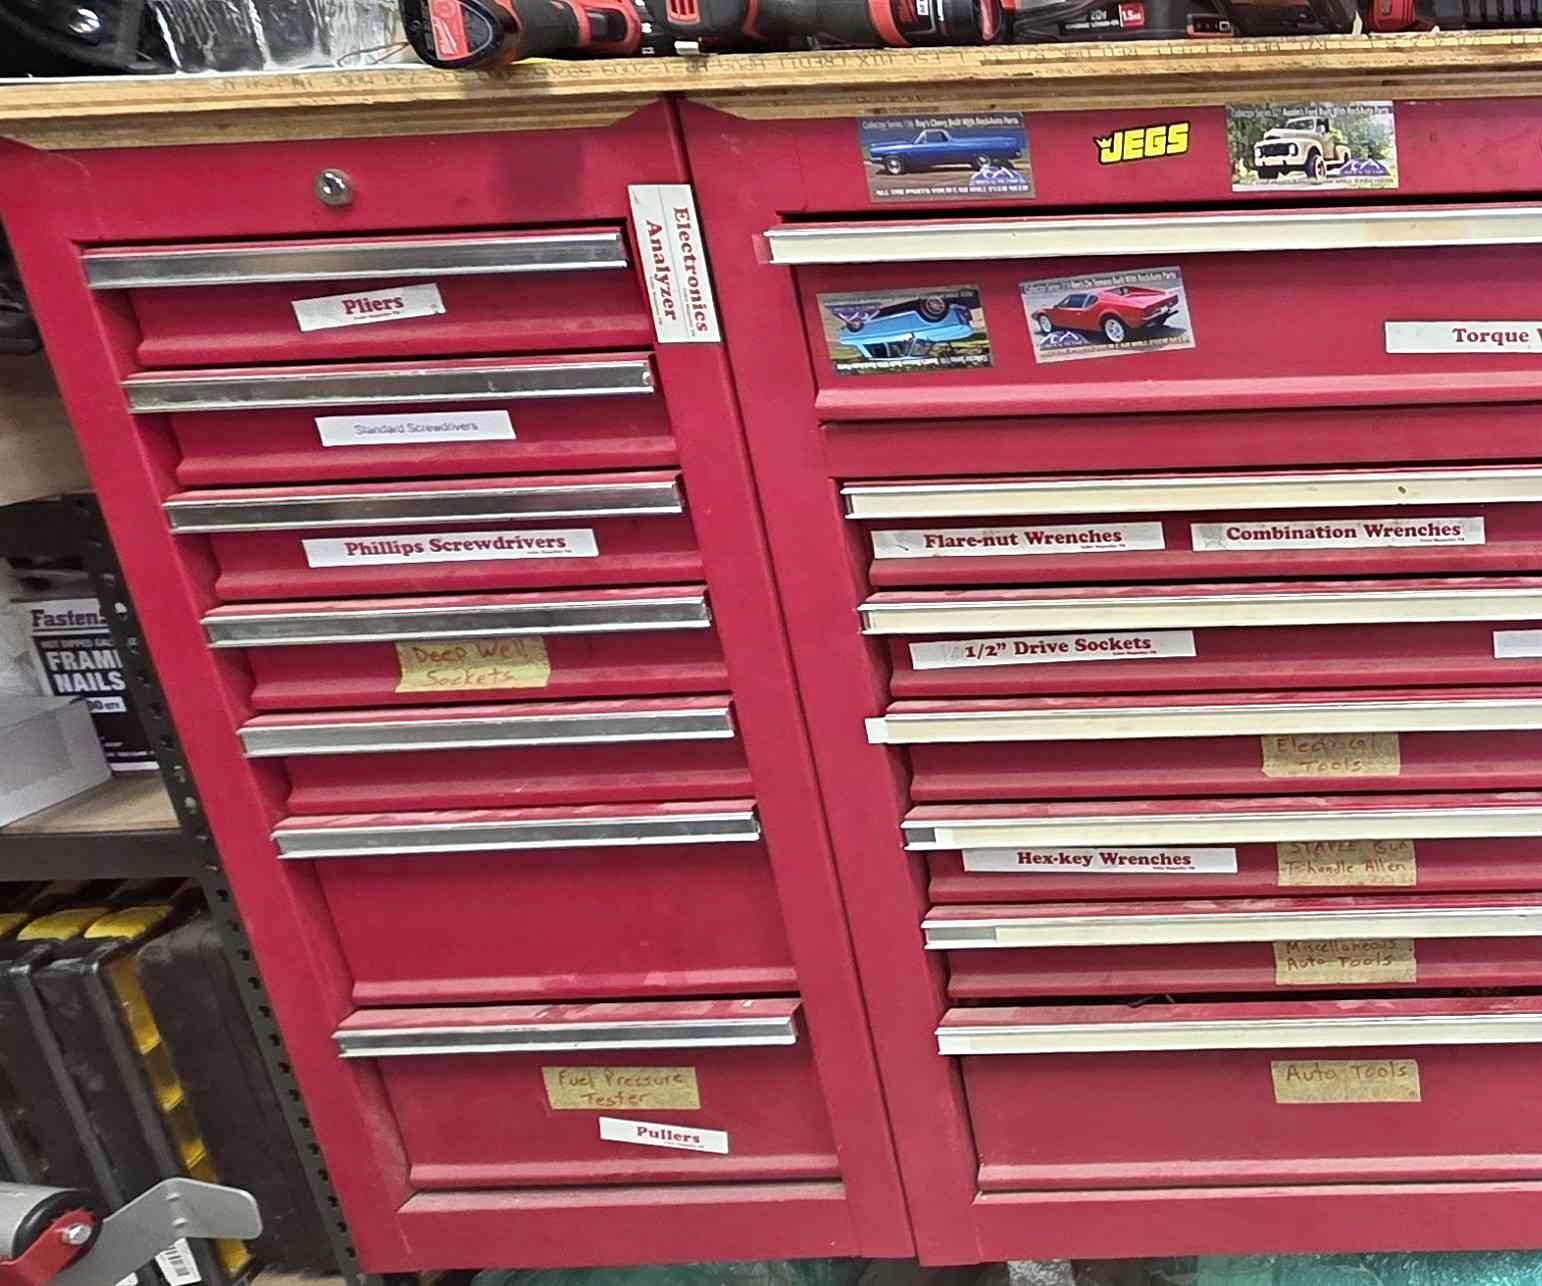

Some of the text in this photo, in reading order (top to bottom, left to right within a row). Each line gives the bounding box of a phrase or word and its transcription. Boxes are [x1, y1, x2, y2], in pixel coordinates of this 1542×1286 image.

[1099, 122, 1190, 164] JEGS
[646, 219, 677, 321] Analyzer
[673, 207, 709, 332] Electronics
[342, 296, 404, 315] Pliers
[1451, 328, 1530, 346] Torque
[354, 421, 479, 435] Standard Screwdrivers
[923, 528, 1123, 550] Flare-nut Wrenches
[1226, 521, 1462, 542] Combination Wrenches
[345, 535, 567, 558] Phillips Screwdrivers
[412, 646, 466, 662] Deep
[1013, 639, 1070, 656] Drive
[1074, 635, 1152, 653] Sockets
[53, 671, 127, 693] NAILS
[1298, 757, 1362, 772] Tools
[1017, 851, 1192, 868] Hex-key Wrenches
[1287, 953, 1394, 972] Auto Tools
[558, 1069, 684, 1087] Fuel Pressure
[1287, 1061, 1407, 1081] Auto Tools
[581, 1092, 649, 1107] Tester
[636, 1126, 701, 1144] Pullers
